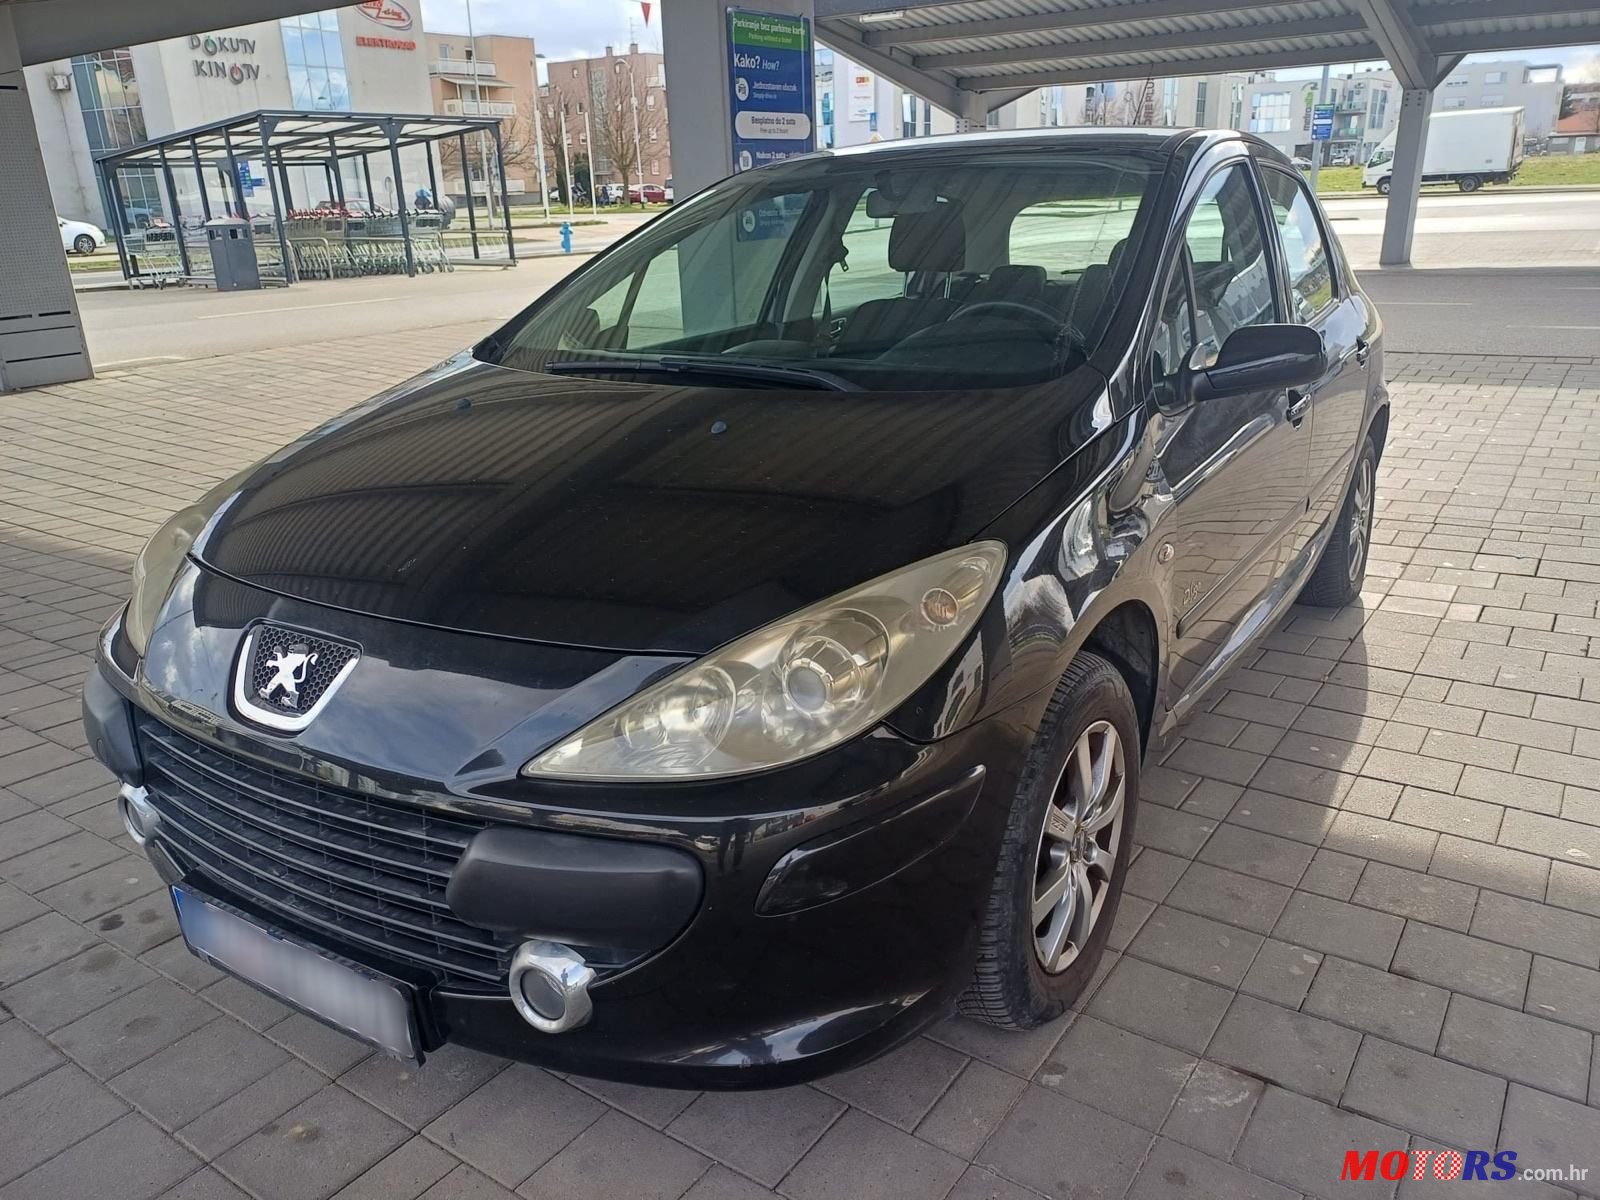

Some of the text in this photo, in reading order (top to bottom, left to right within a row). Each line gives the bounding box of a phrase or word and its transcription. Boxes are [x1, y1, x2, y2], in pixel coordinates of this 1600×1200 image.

[760, 21, 770, 31] bez
[734, 53, 780, 71] Kako? How?
[751, 116, 775, 126] Besplatno
[775, 117, 782, 125] do
[772, 151, 776, 159] 2
